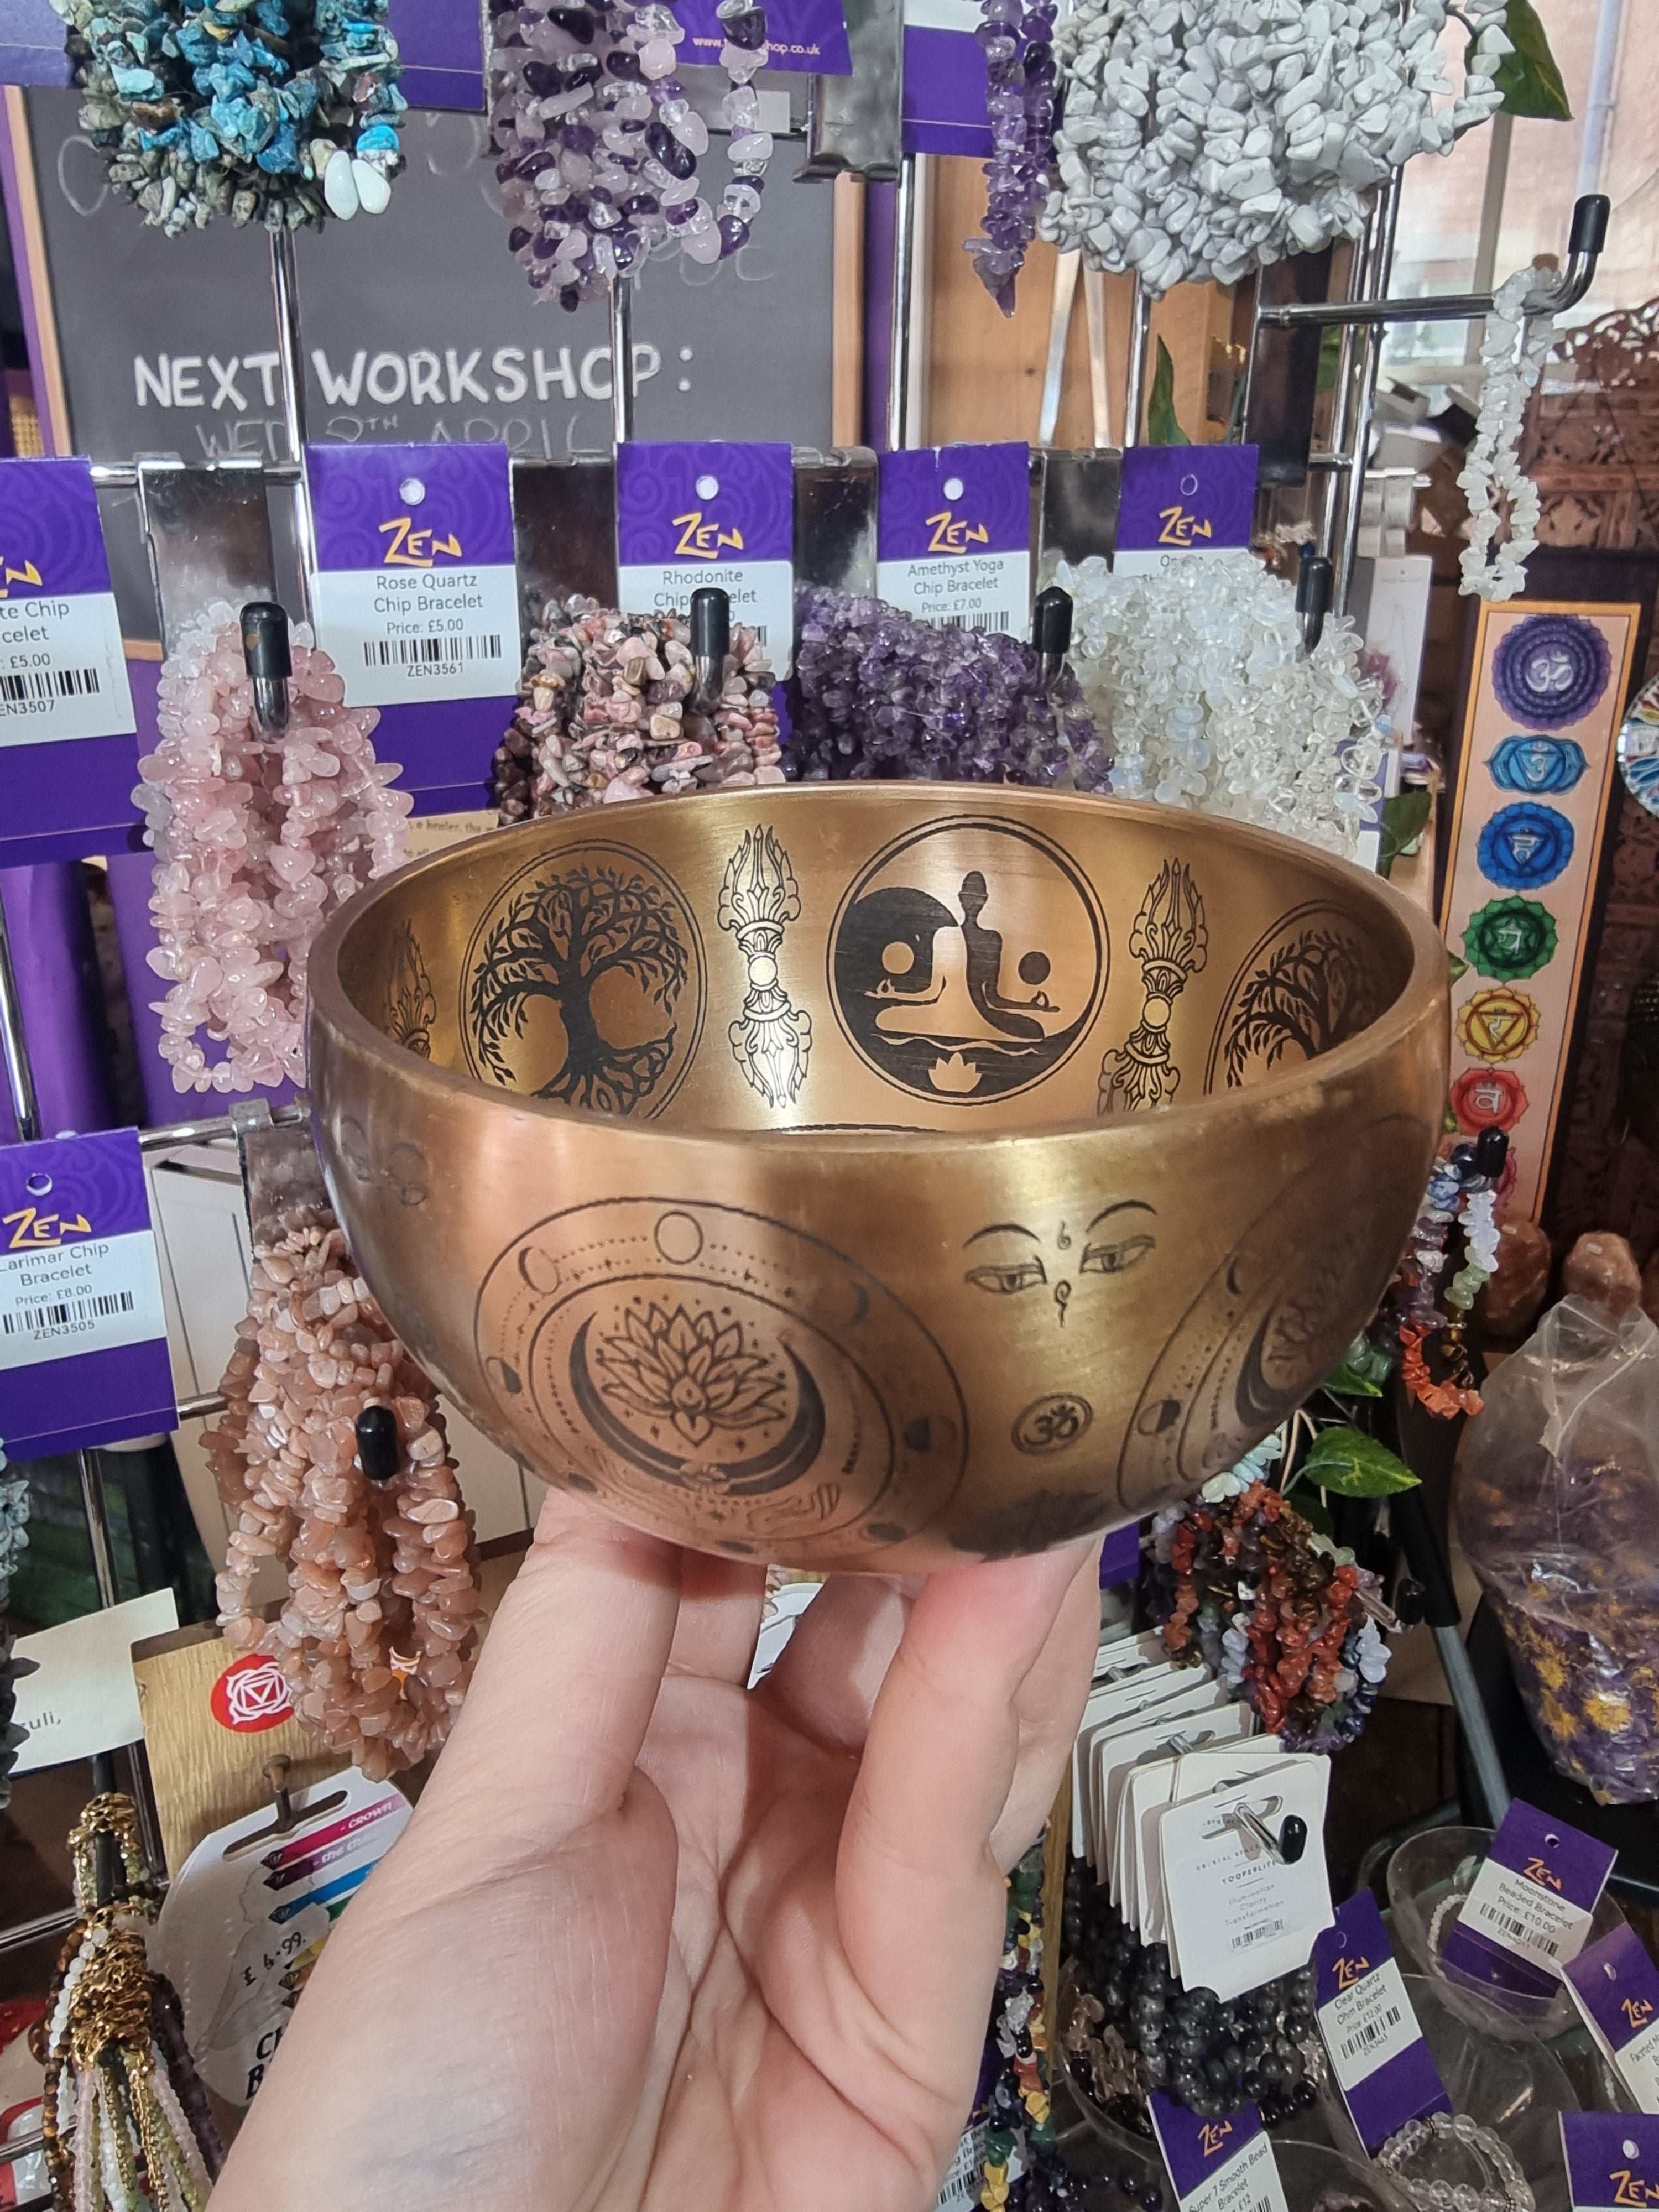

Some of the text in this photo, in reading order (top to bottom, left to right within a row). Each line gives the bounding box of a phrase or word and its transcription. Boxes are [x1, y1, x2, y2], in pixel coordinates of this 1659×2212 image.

[134, 352, 280, 411] NEXT
[672, 512, 744, 559] ZEN
[926, 511, 989, 554] ZEN
[1159, 506, 1212, 546] ZEN
[379, 517, 462, 567] ZEN
[663, 569, 743, 585] Rhodonite
[907, 559, 1004, 577] Amethyst Yoga
[377, 574, 477, 591] Rose Quartz
[913, 577, 999, 597] Chip Bracelet
[25, 600, 69, 620] Chip
[374, 593, 483, 615] Chip Bracelet
[654, 589, 757, 609] Chip elet
[921, 597, 982, 613] Price: £7.00
[0, 625, 50, 644] celet
[387, 618, 464, 635] Price: £5.00
[10, 653, 51, 669] £5.00
[406, 662, 463, 677] ZEN3561
[2, 1207, 92, 1249] ZEN
[70, 1243, 110, 1259] Chip
[20, 1263, 93, 1287] Bracelet
[15, 1284, 93, 1307] Price: £8.00
[33, 1319, 96, 1341] ZEN3505
[20, 1710, 61, 1730] uli,
[1523, 1856, 1563, 1891] ZEN
[1499, 1882, 1574, 1931] Beaded Bracelet
[1515, 1878, 1566, 1913] Moonstone
[1332, 1957, 1369, 1990] ZEN
[1355, 1973, 1381, 1995] Quartz
[1356, 1984, 1387, 2011] Bracelet
[1621, 1998, 1653, 2028] ZEN
[1198, 2120, 1233, 2157] ZEN
[1219, 2161, 1249, 2192] Smooth
[1248, 2142, 1269, 2166] Bead
[1217, 2178, 1249, 2211] Bracelet
[1609, 2169, 1659, 2208] ZEN
